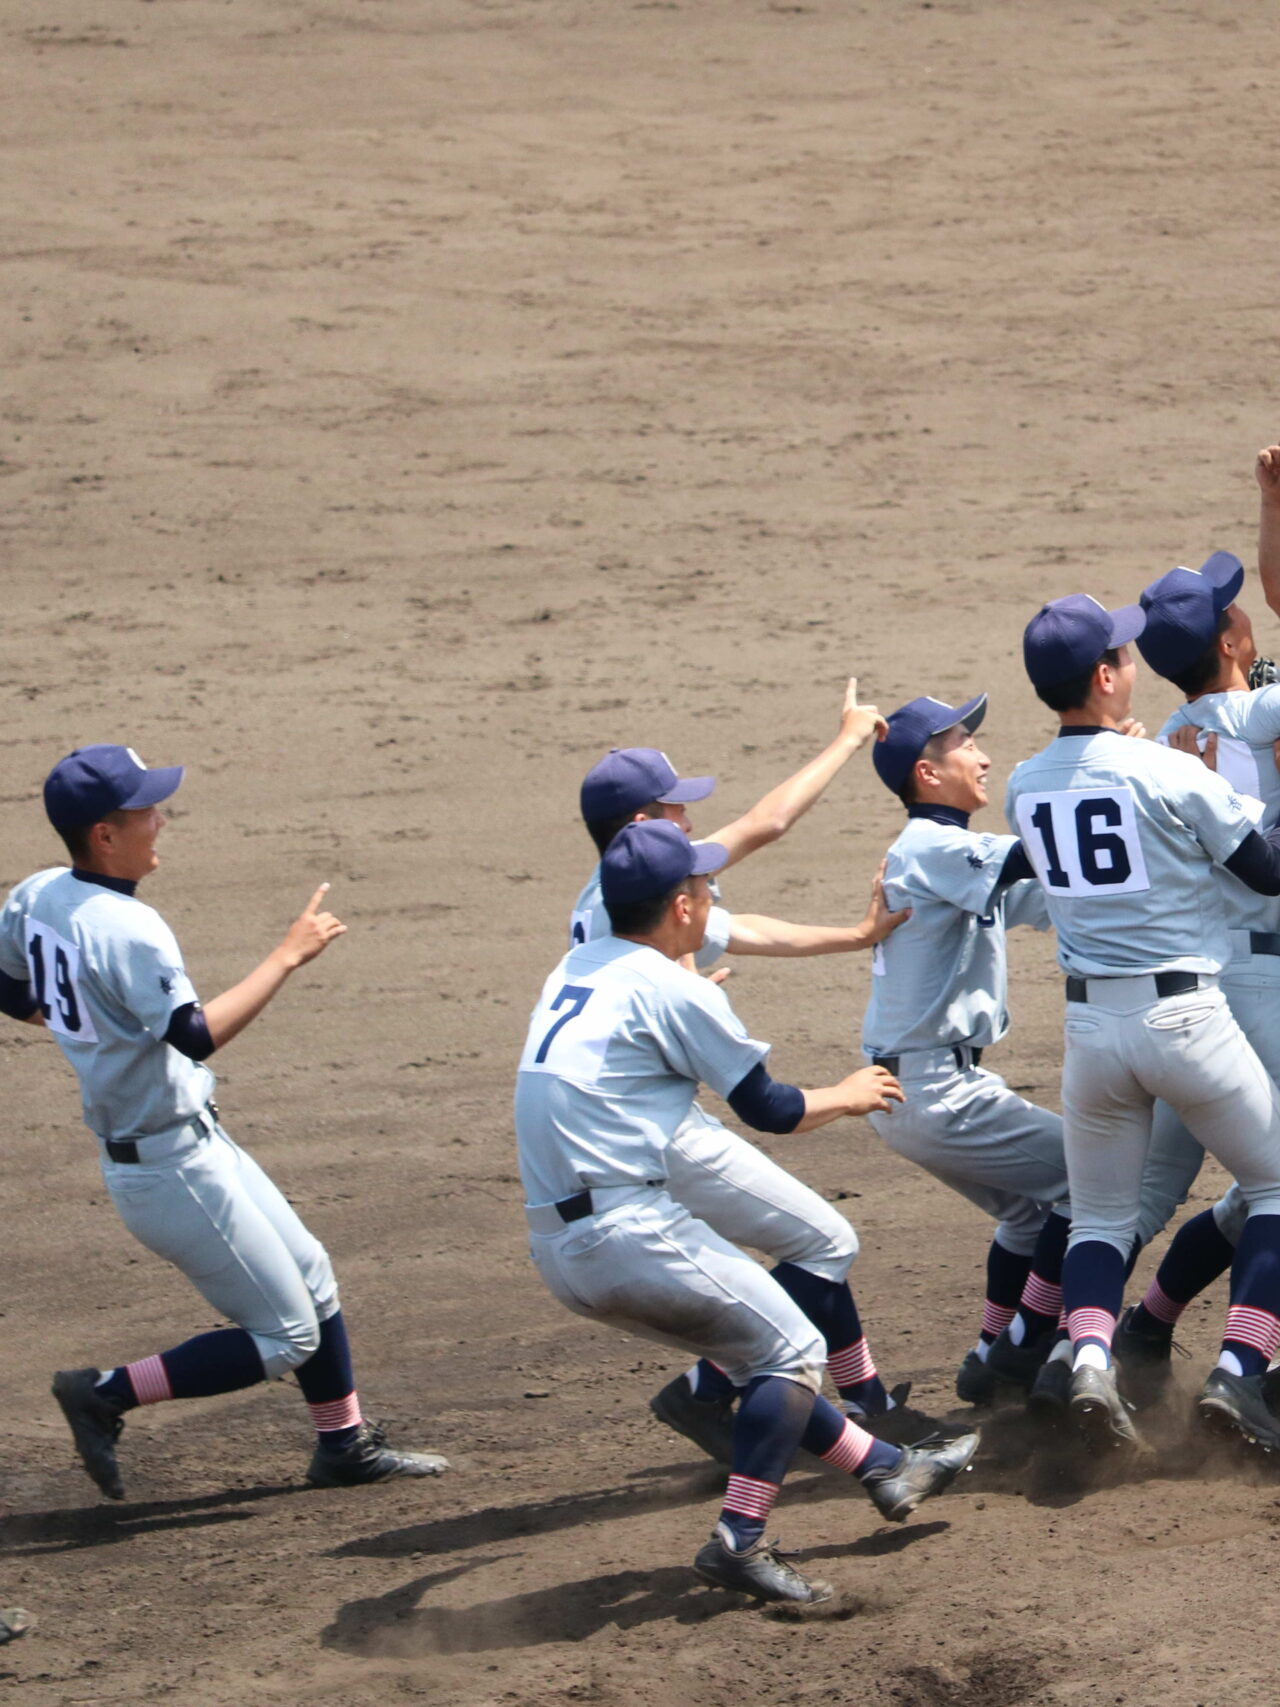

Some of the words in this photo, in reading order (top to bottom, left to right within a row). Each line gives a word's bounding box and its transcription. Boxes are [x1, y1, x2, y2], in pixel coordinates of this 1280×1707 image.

[1031, 797, 1132, 888] 16
[29, 933, 82, 1033] 19
[534, 984, 595, 1064] 7
